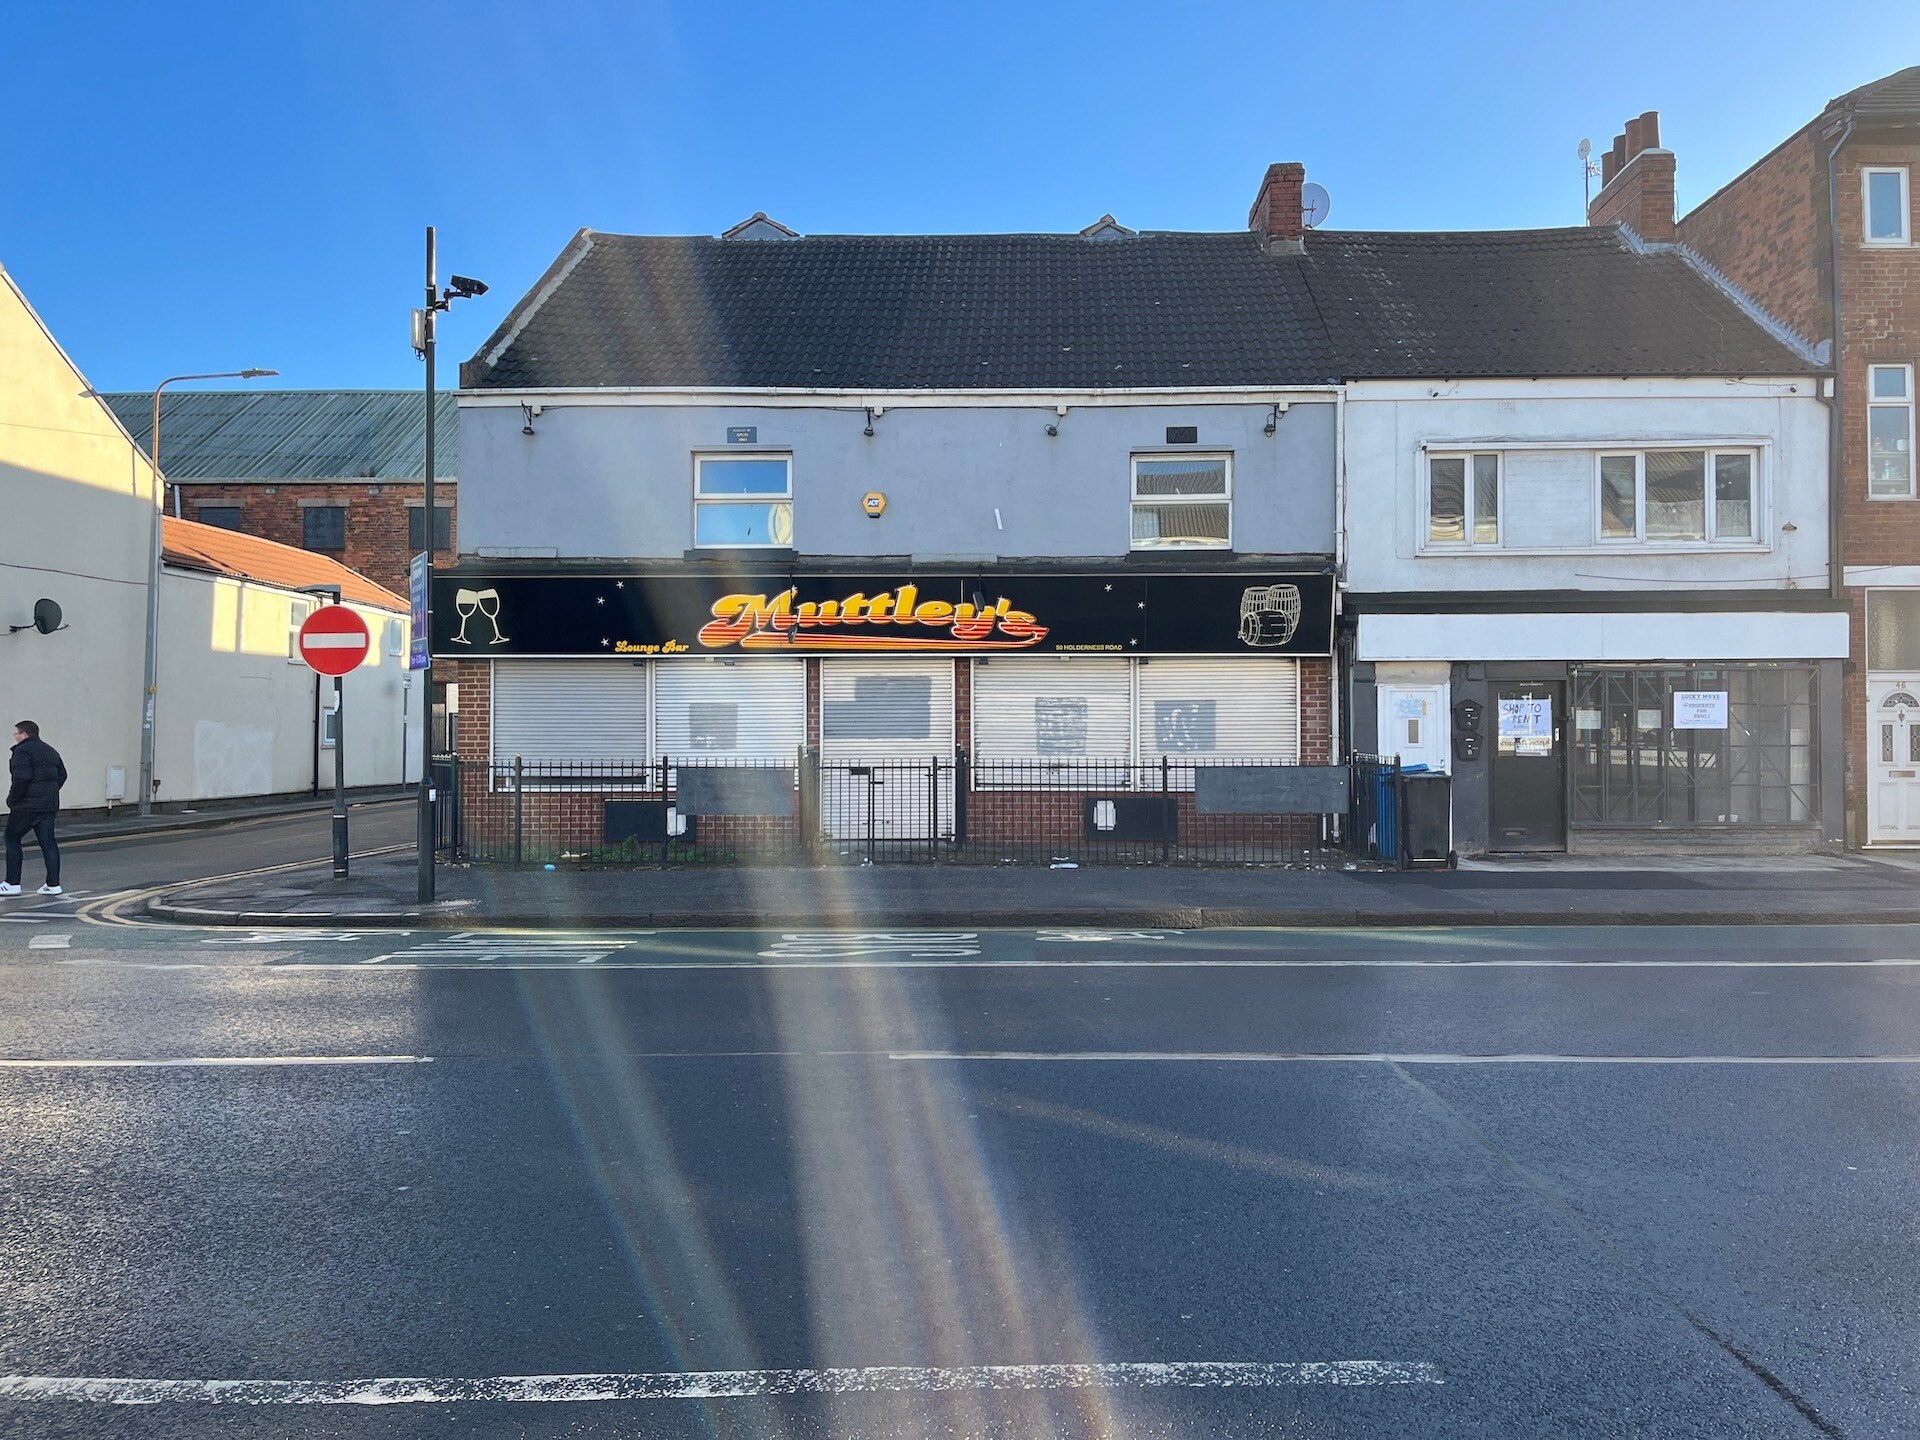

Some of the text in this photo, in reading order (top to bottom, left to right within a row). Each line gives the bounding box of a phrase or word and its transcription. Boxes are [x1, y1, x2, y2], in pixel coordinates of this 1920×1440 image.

[868, 499, 880, 507] ADT
[697, 583, 1050, 651] Muttley's
[614, 639, 690, 655] Lounge Bar
[1503, 703, 1542, 715] SHOP TO
[1512, 714, 1541, 724] RENT
[359, 931, 656, 964] LANE
[757, 933, 981, 957] BUS
